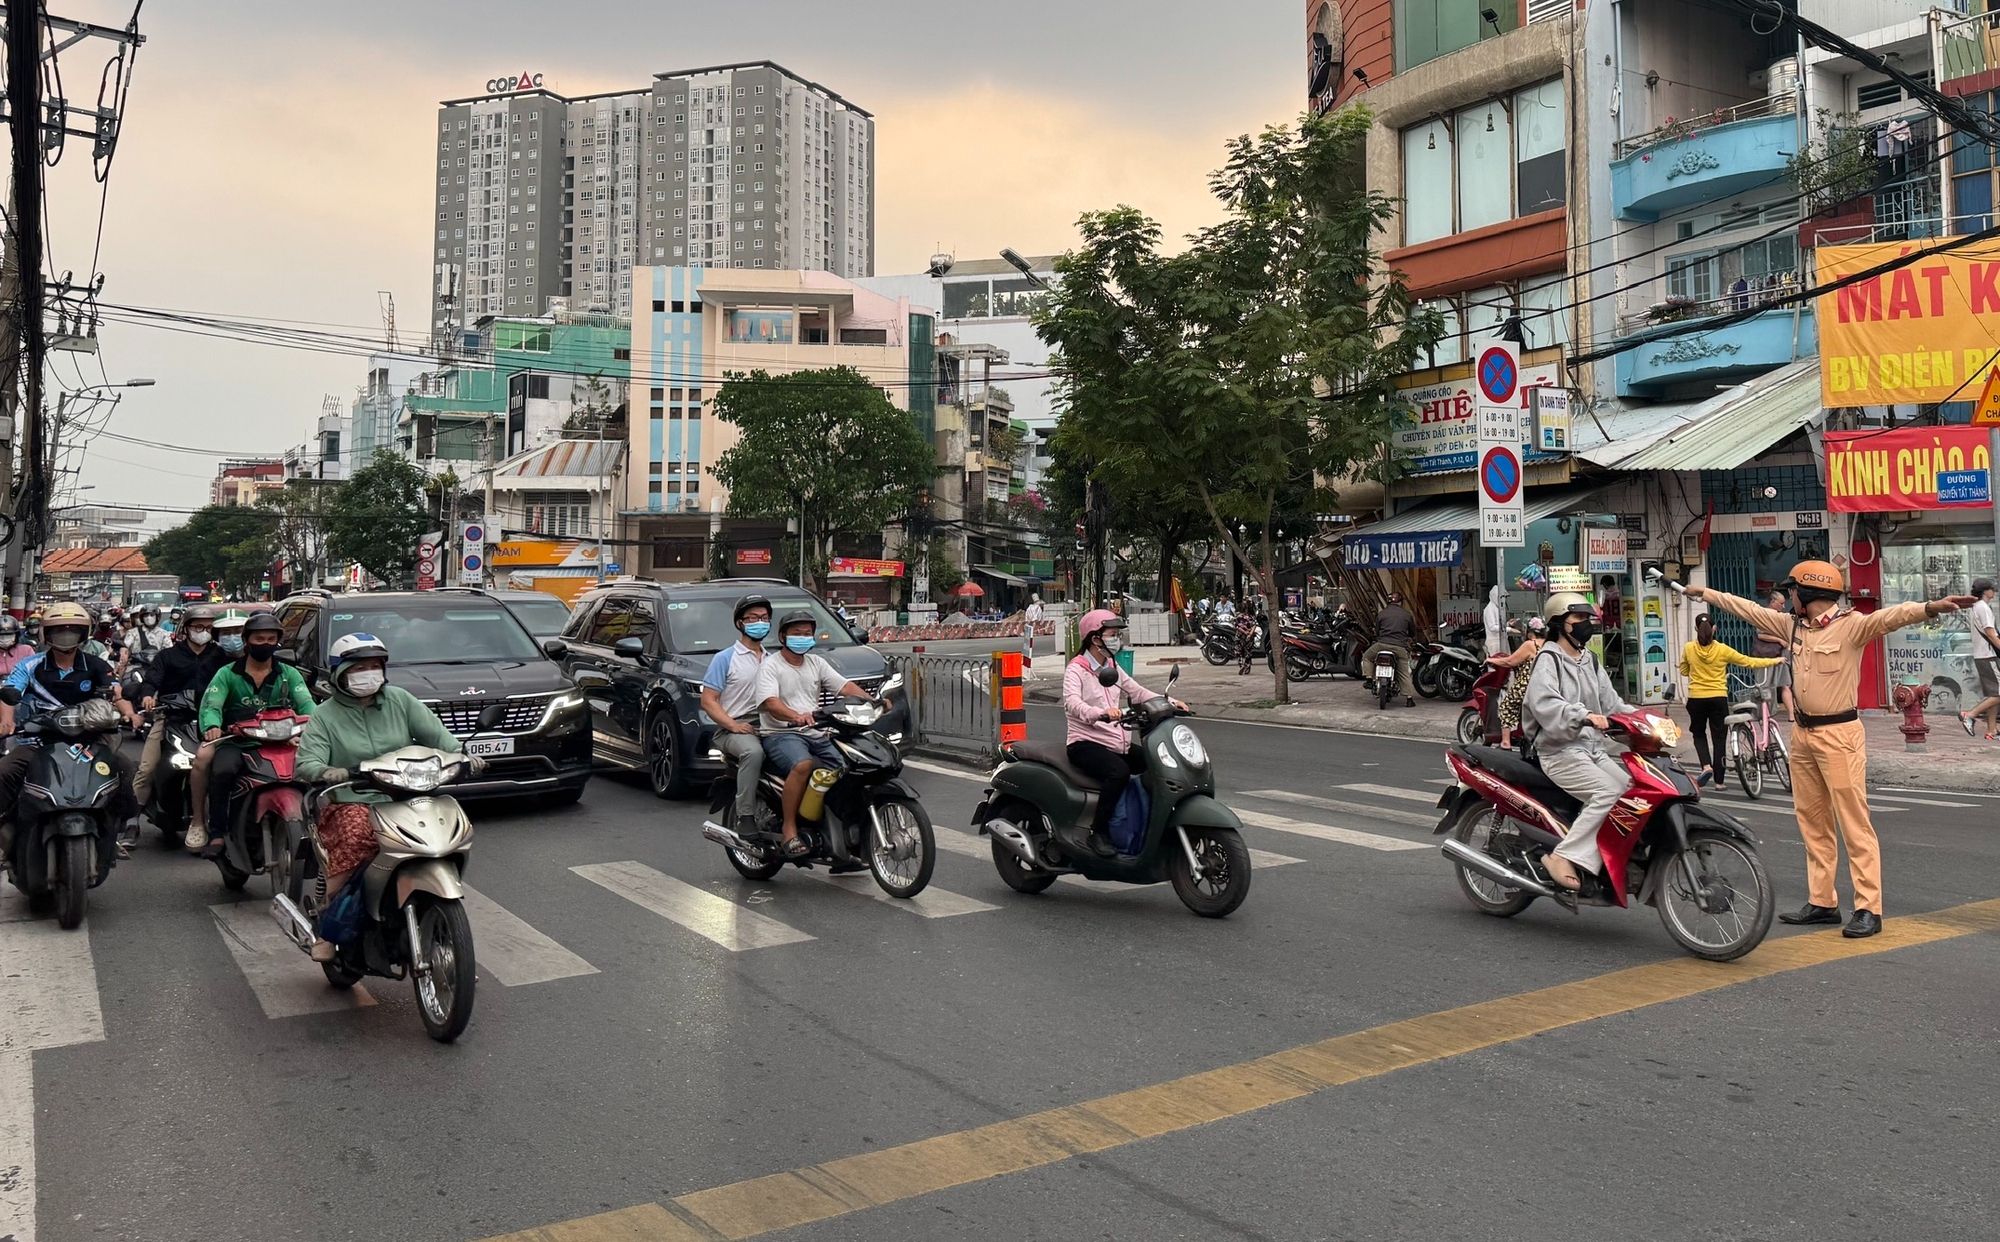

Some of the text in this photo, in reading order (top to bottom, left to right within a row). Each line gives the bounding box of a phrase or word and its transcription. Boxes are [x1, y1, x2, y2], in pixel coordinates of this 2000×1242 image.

[1829, 355, 1871, 393] BV
[1879, 345, 1954, 397] ĐIỆN
[1438, 385, 1452, 397] CÁO
[1421, 389, 1474, 424] HIỆ
[1402, 428, 1431, 442] CHUYÊN
[1448, 424, 1464, 436] VĂN
[1466, 424, 1477, 435] PH
[1829, 441, 1890, 497] KÍNH
[1946, 474, 1977, 484] ĐƯỜNG
[1958, 485, 1968, 498] TẤT
[1969, 484, 1987, 498] THÀNH
[1797, 513, 1821, 525] 96B
[1345, 538, 1370, 565] DẤU
[1381, 541, 1415, 564] DANH
[1419, 535, 1459, 563] THIẾP
[1591, 532, 1610, 555] KHẮC
[1611, 532, 1626, 555] DẤU
[1596, 561, 1610, 570] DANH
[1611, 558, 1626, 571] THIẾP
[1802, 573, 1833, 584] CSGT
[1888, 648, 1919, 659] TRONG
[1889, 658, 1924, 672] SẮC NÉT
